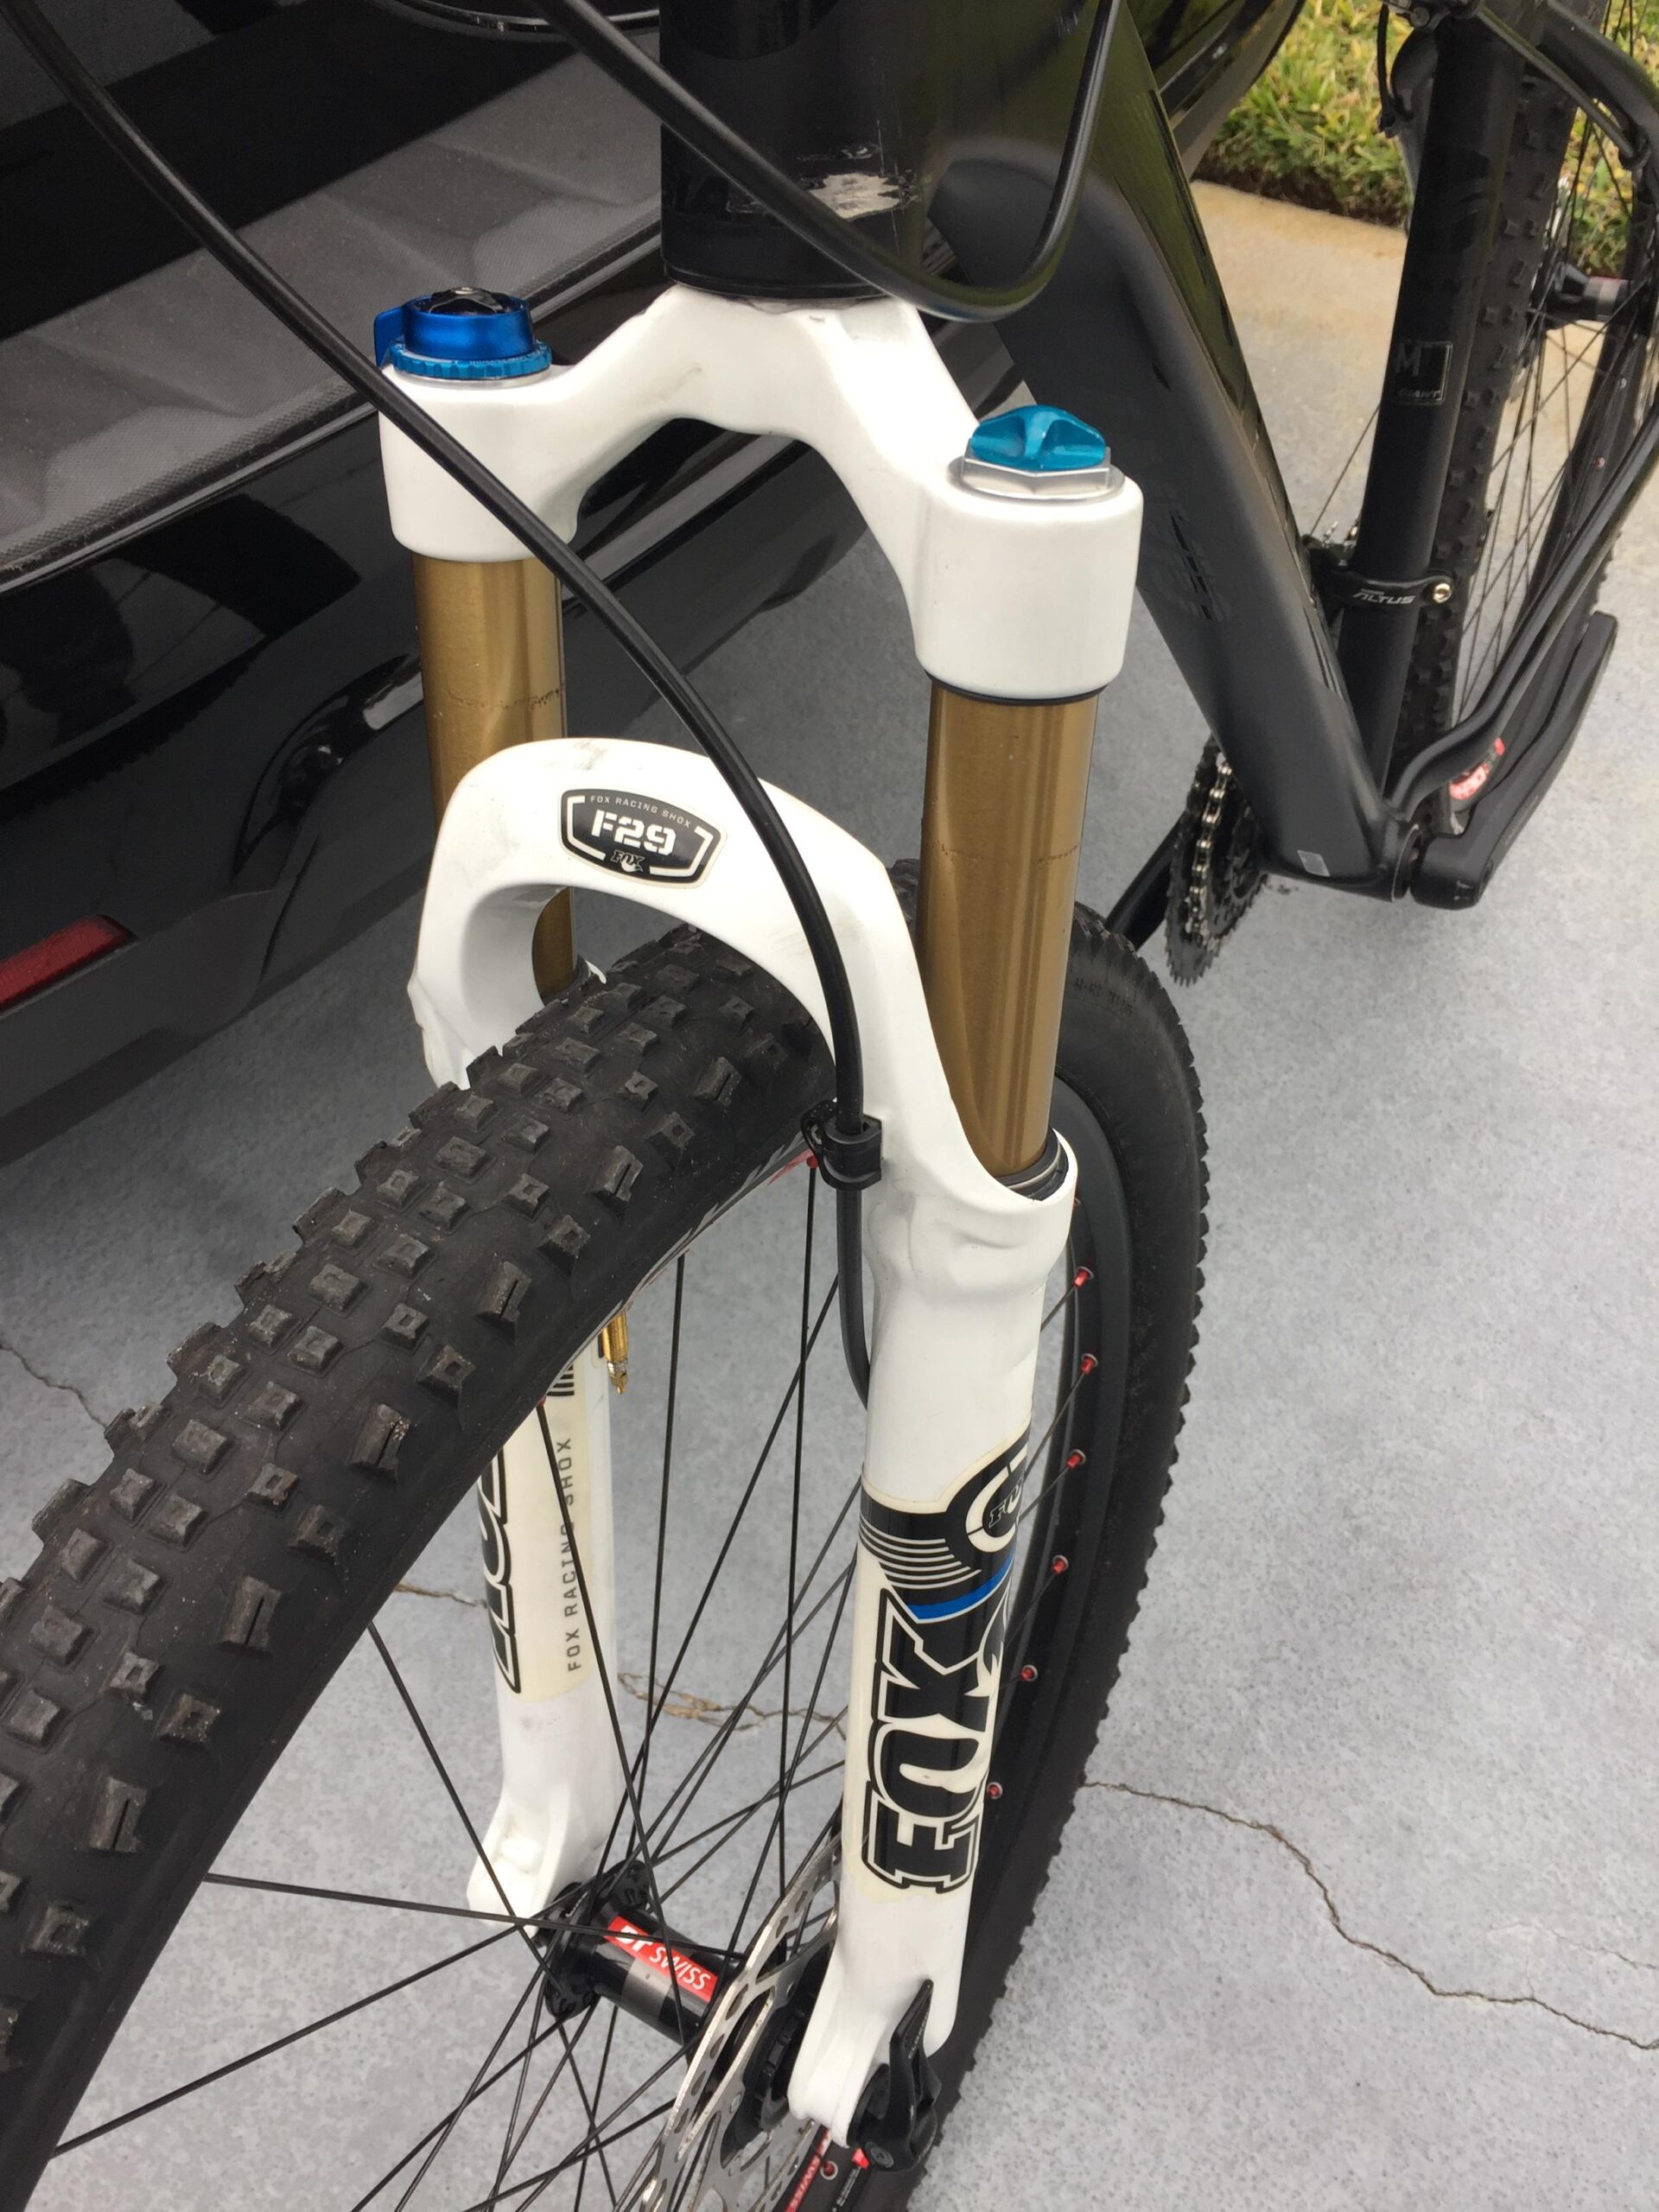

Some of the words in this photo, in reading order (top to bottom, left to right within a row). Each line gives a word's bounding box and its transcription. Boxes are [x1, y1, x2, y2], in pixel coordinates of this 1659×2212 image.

[1352, 592, 1416, 605] ALTUS
[590, 795, 611, 804] FOX
[615, 797, 658, 814] RACING
[662, 810, 692, 829] SHOX
[590, 809, 677, 856] F29
[610, 849, 646, 873] FOX
[565, 1629, 582, 1672] FOX
[649, 1945, 712, 1991] SWISS
